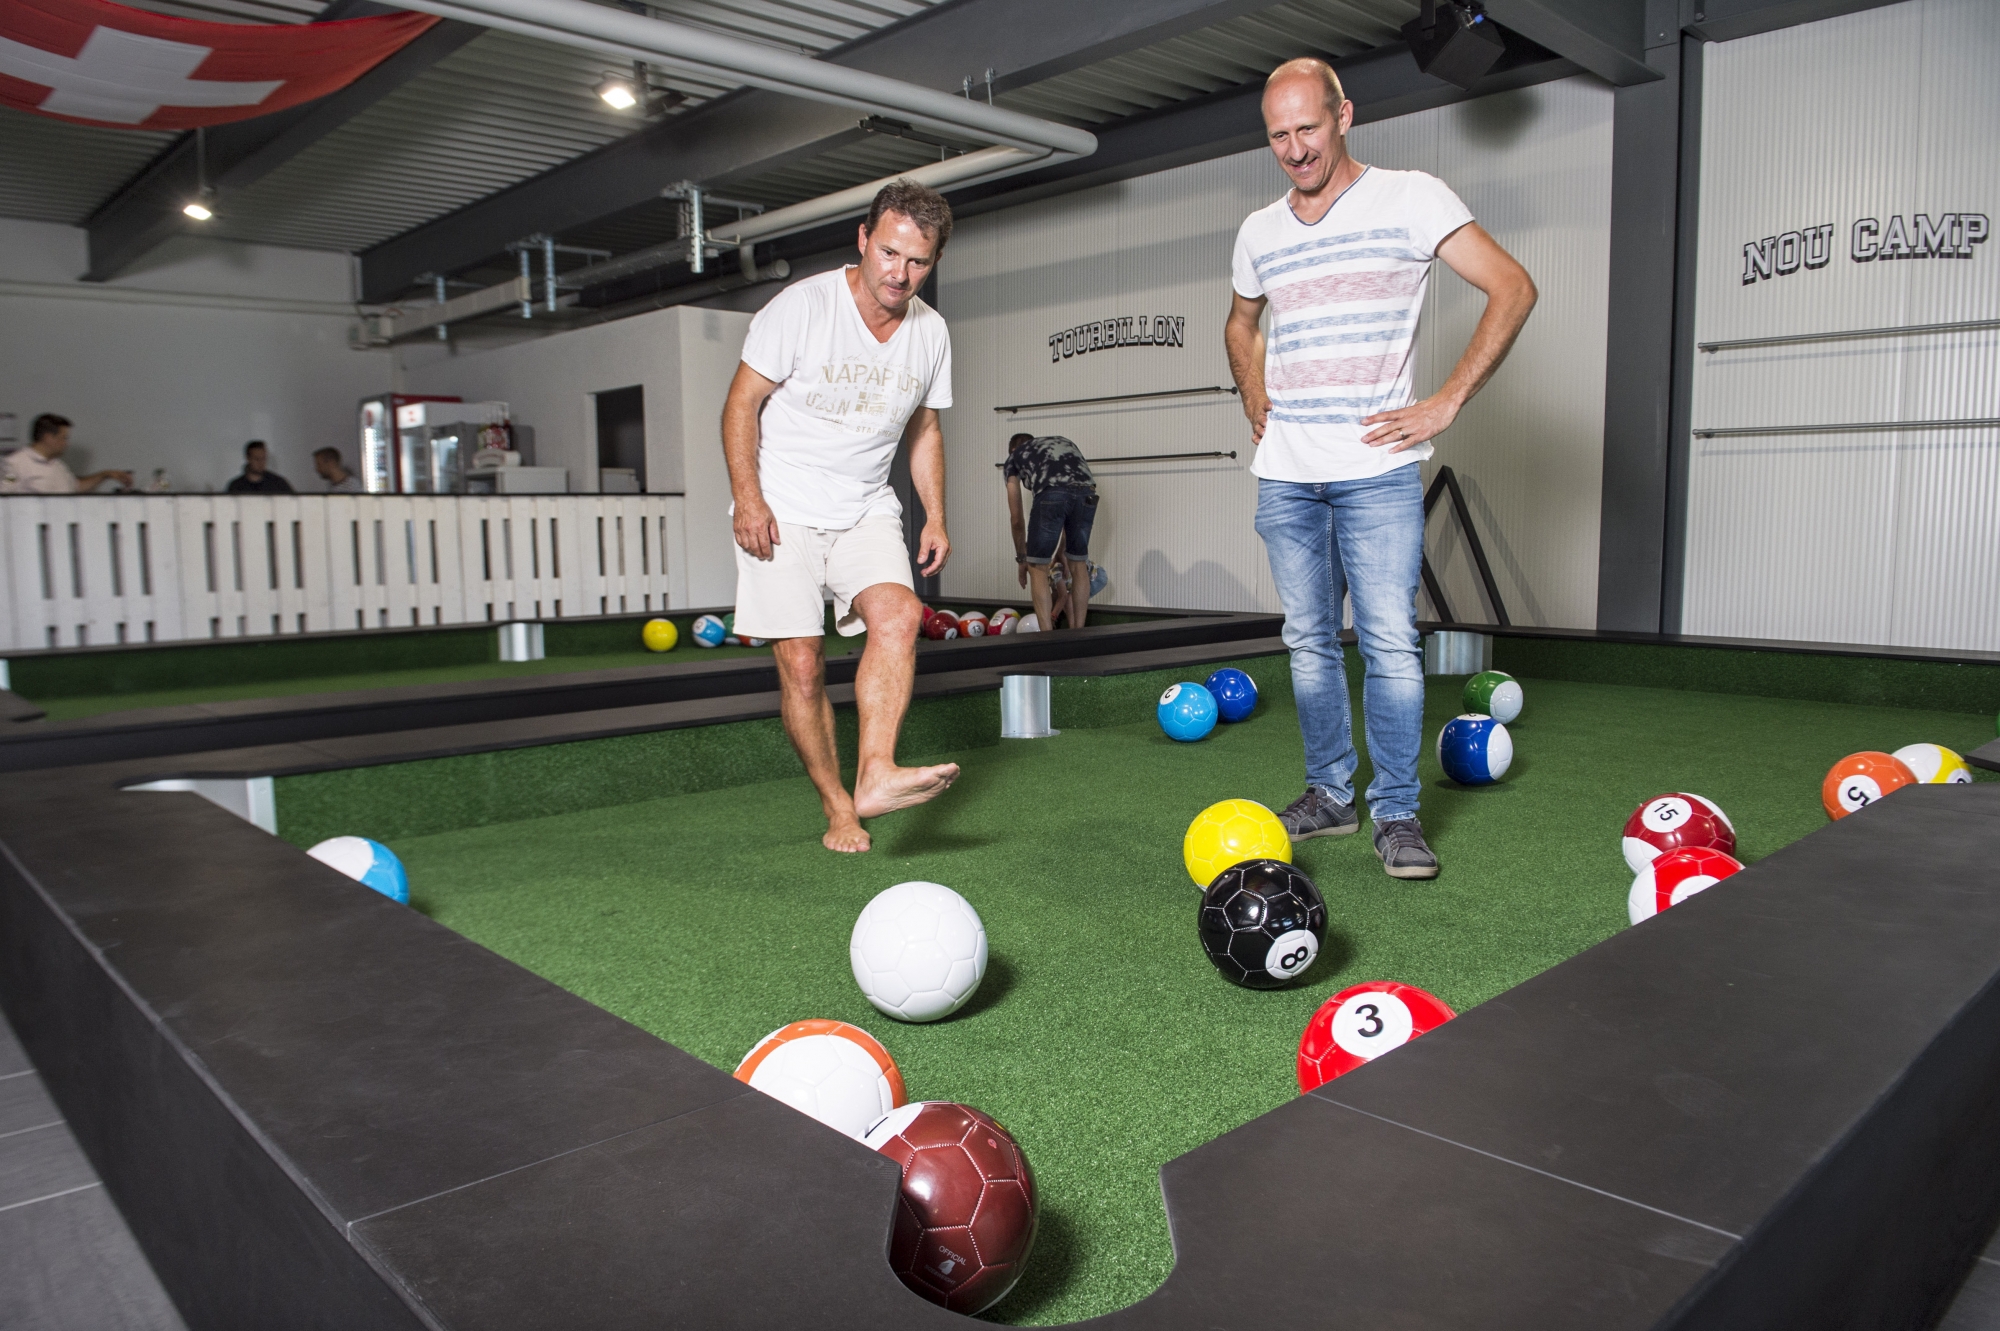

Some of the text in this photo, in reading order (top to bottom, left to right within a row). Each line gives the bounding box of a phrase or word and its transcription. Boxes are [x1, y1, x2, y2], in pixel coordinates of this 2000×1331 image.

[1742, 213, 1989, 286] NOU CAMP
[1049, 316, 1184, 363] TOURBILLON
[1847, 786, 1871, 807] 5
[1654, 802, 1679, 821] 15
[1280, 945, 1309, 970] 8
[1354, 1003, 1384, 1038] 3
[938, 1245, 967, 1266] OFFICIAL
